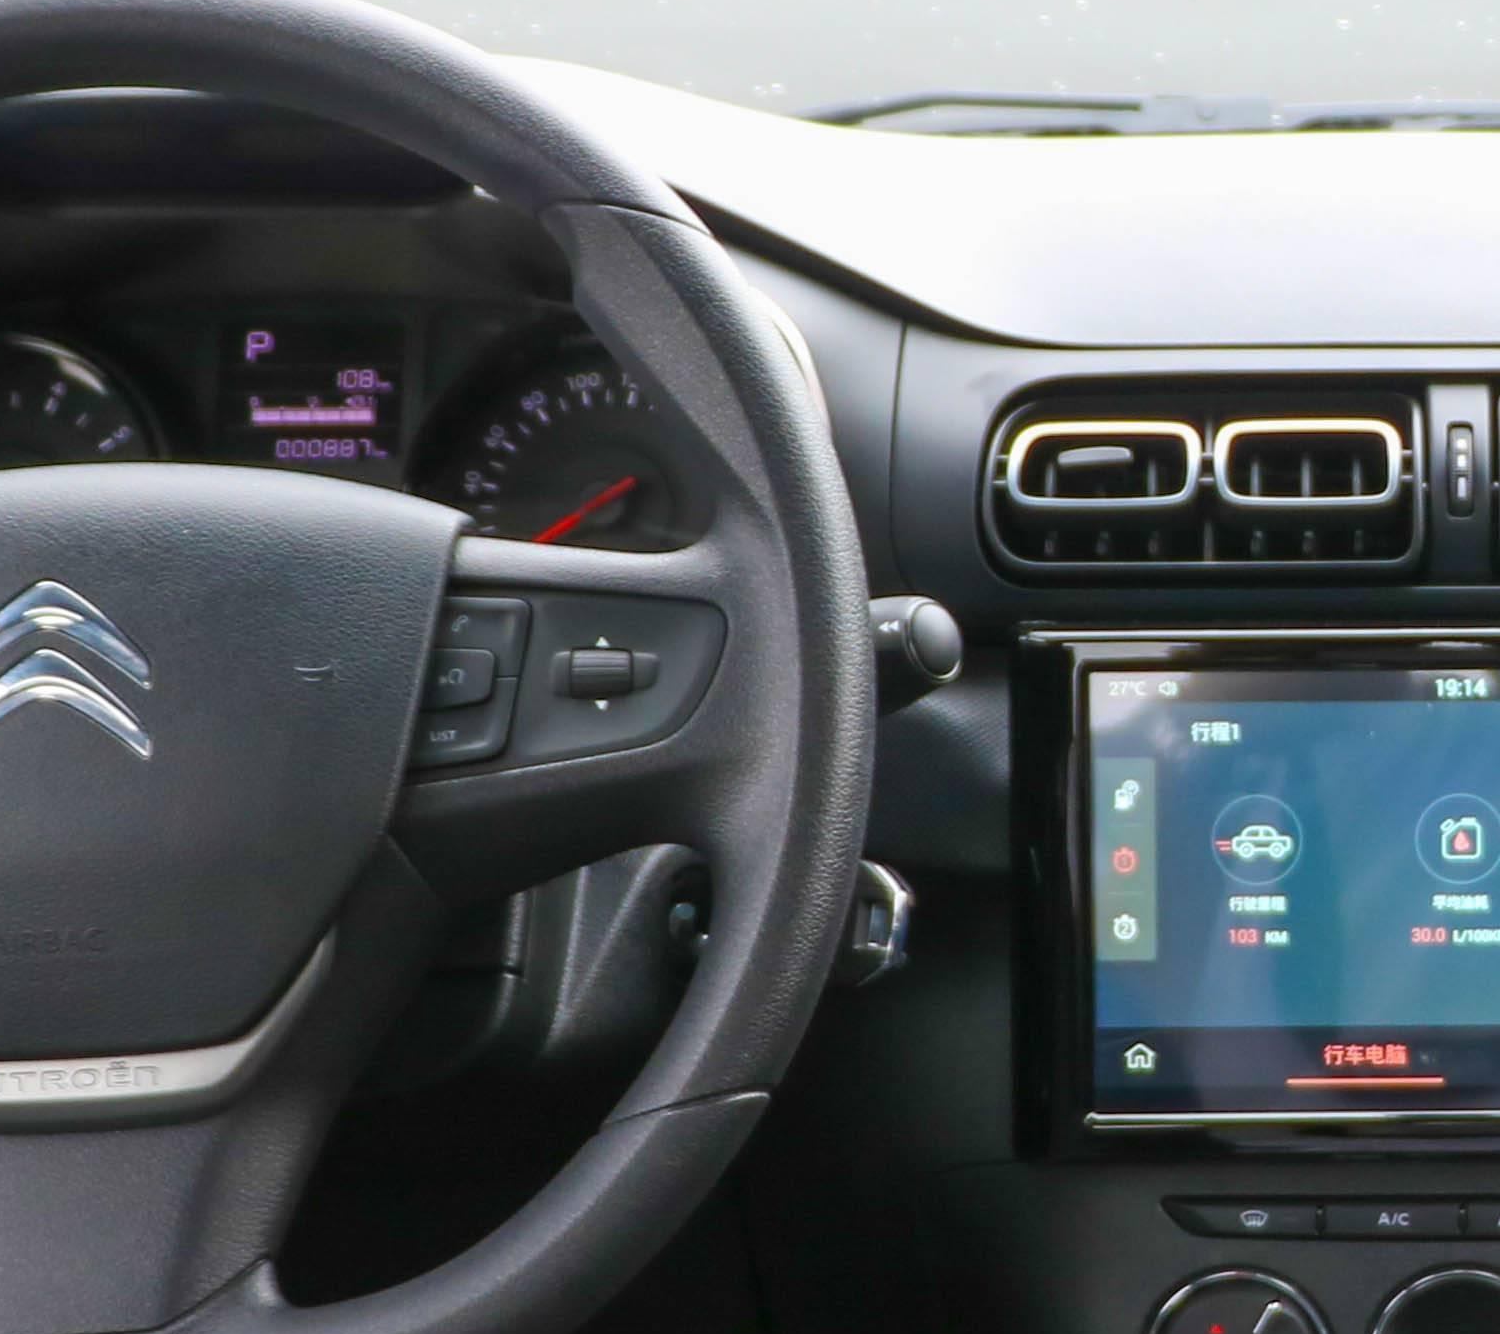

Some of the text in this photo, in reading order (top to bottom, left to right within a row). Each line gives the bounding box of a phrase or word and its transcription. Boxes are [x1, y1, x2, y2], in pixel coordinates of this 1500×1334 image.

[246, 331, 274, 361] P
[336, 369, 376, 388] 108
[566, 372, 601, 391] 100
[276, 439, 371, 459] 000887
[1435, 678, 1487, 698] 19:14
[429, 729, 457, 742] LIST
[1191, 721, 1241, 743] 行程1
[1229, 928, 1258, 944] 103
[1412, 927, 1446, 943] 30.0
[1324, 1044, 1408, 1066] 行车电脑
[1378, 1212, 1410, 1227] A/C
